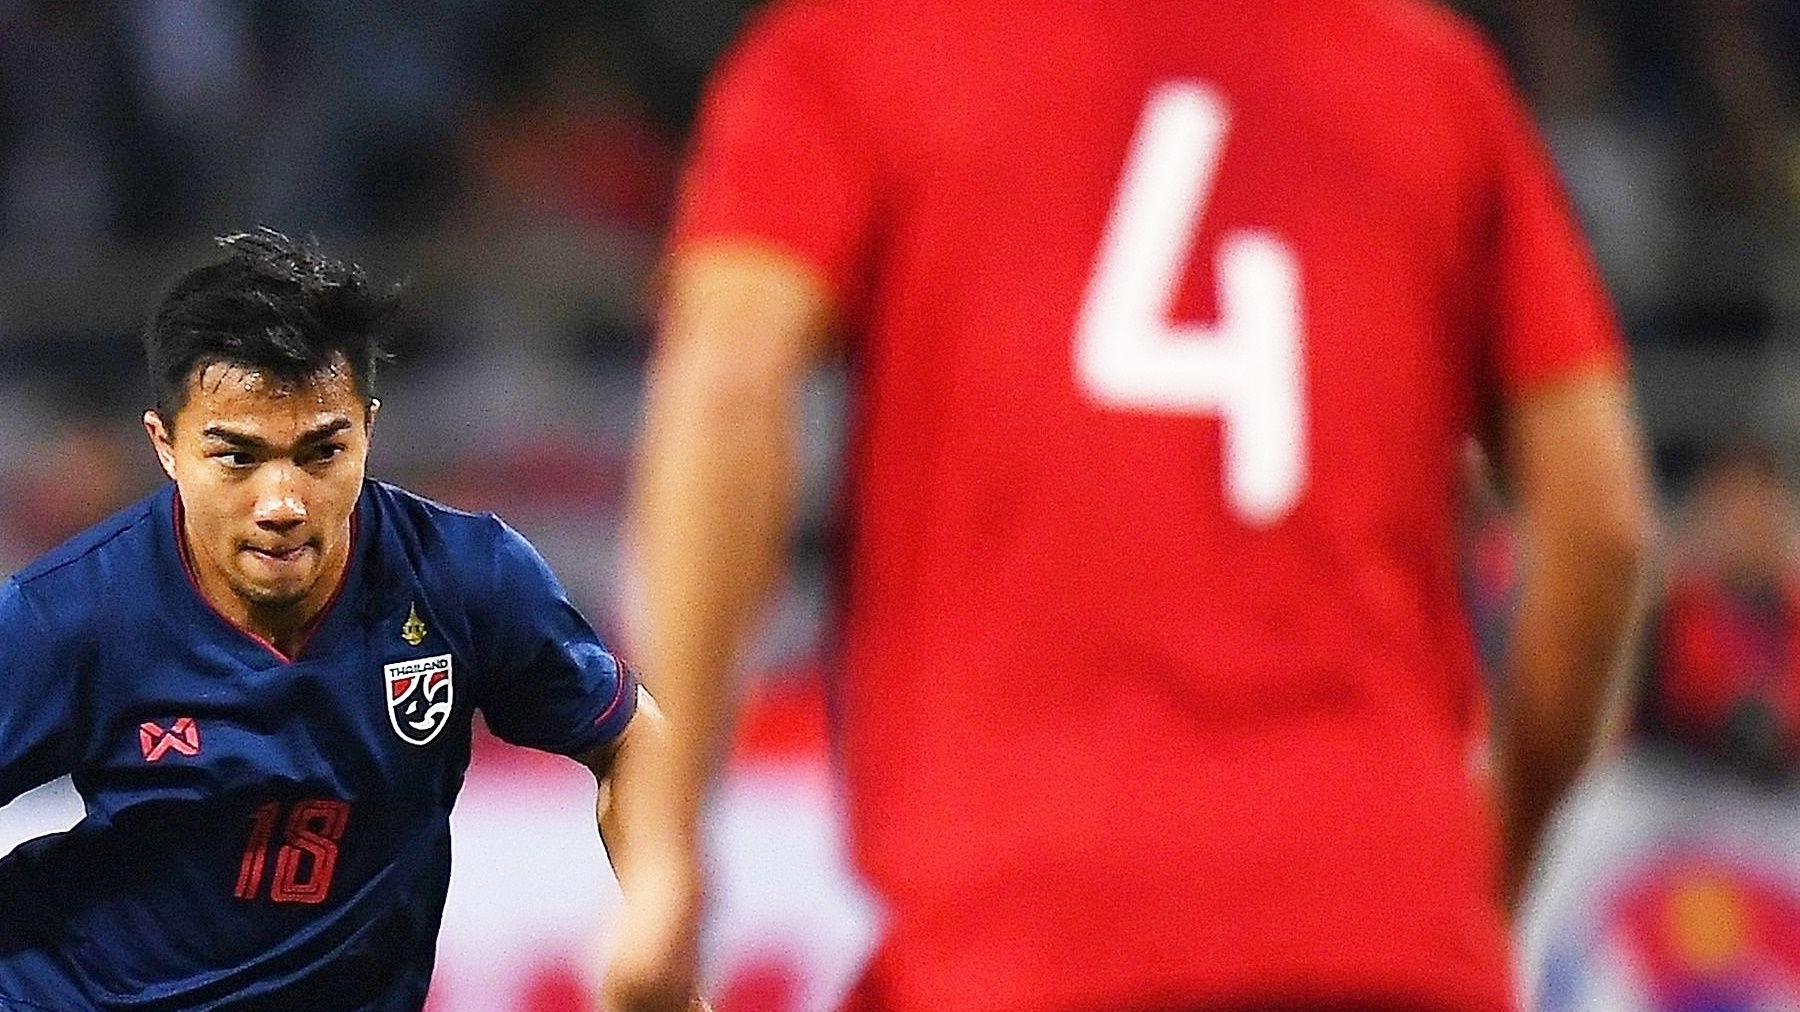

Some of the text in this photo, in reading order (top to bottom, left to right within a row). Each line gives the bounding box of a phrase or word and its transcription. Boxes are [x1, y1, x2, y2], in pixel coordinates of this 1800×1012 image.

[1075, 78, 1308, 526] 4
[390, 659, 449, 677] THAILAND
[234, 800, 351, 904] 18
